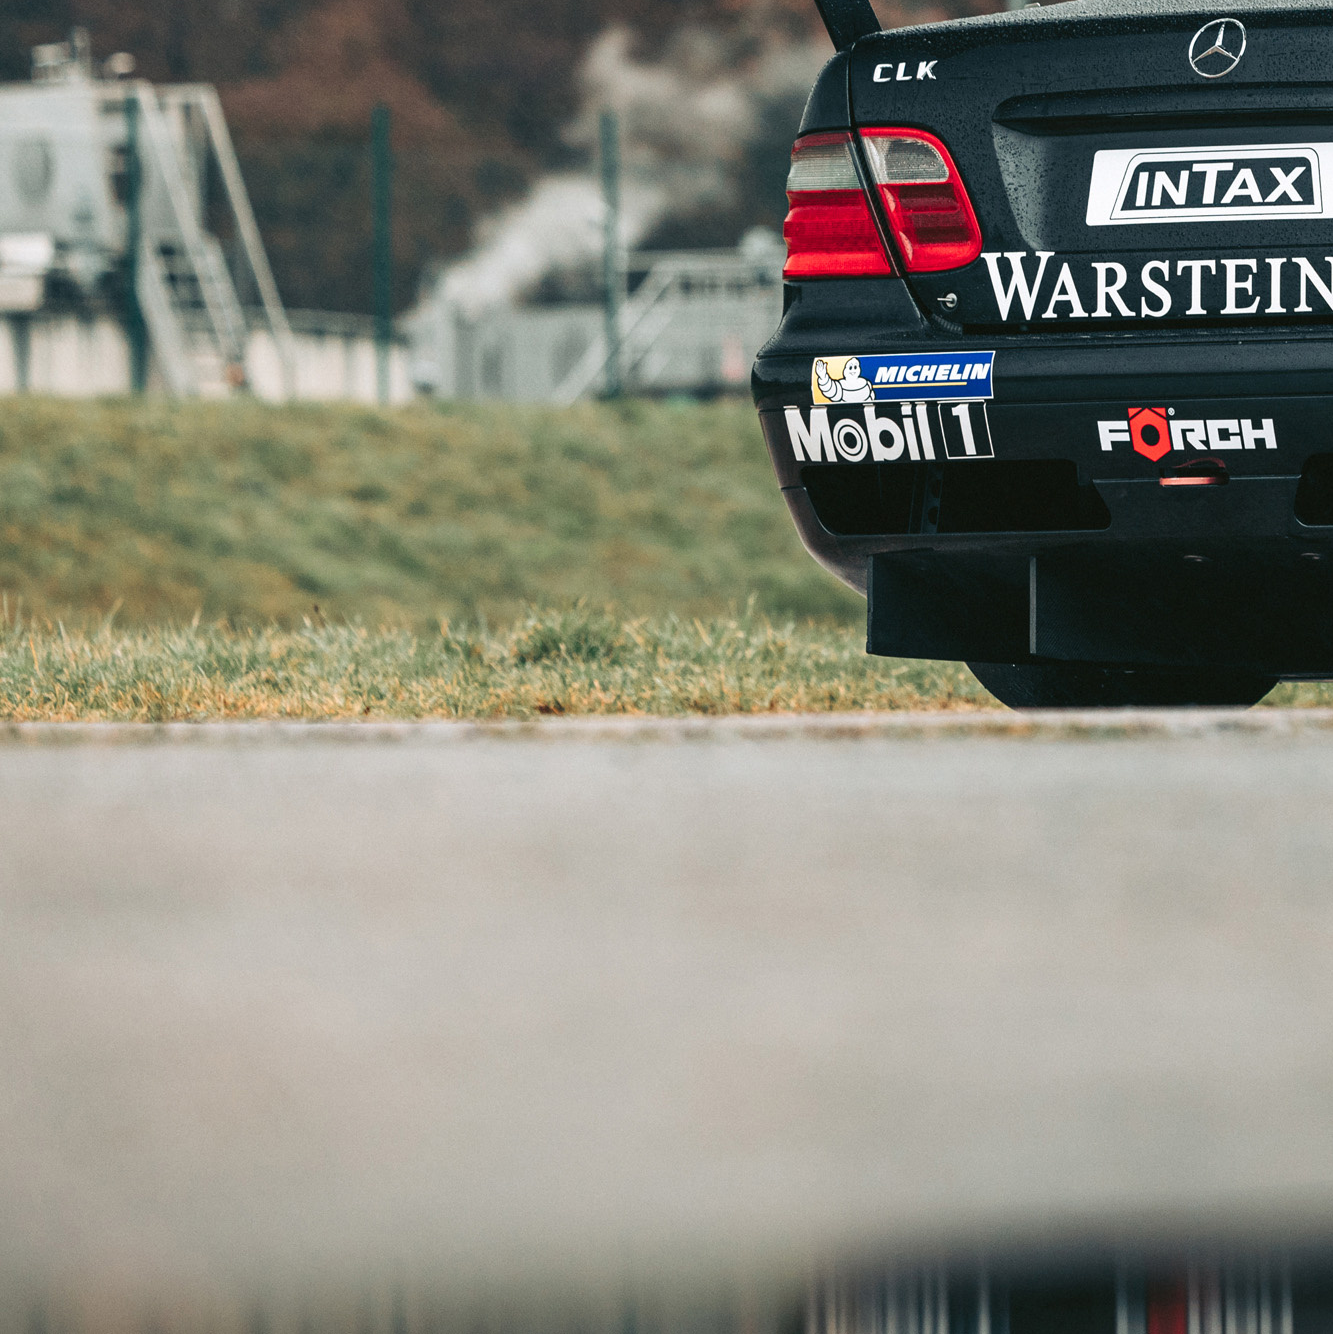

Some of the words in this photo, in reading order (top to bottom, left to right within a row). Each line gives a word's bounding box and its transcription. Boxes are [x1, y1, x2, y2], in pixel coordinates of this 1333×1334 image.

[873, 60, 938, 83] CLK
[1135, 162, 1307, 207] INTAX
[874, 362, 991, 383] MICHELIN
[783, 401, 936, 462] Mobil
[951, 403, 977, 456] 1
